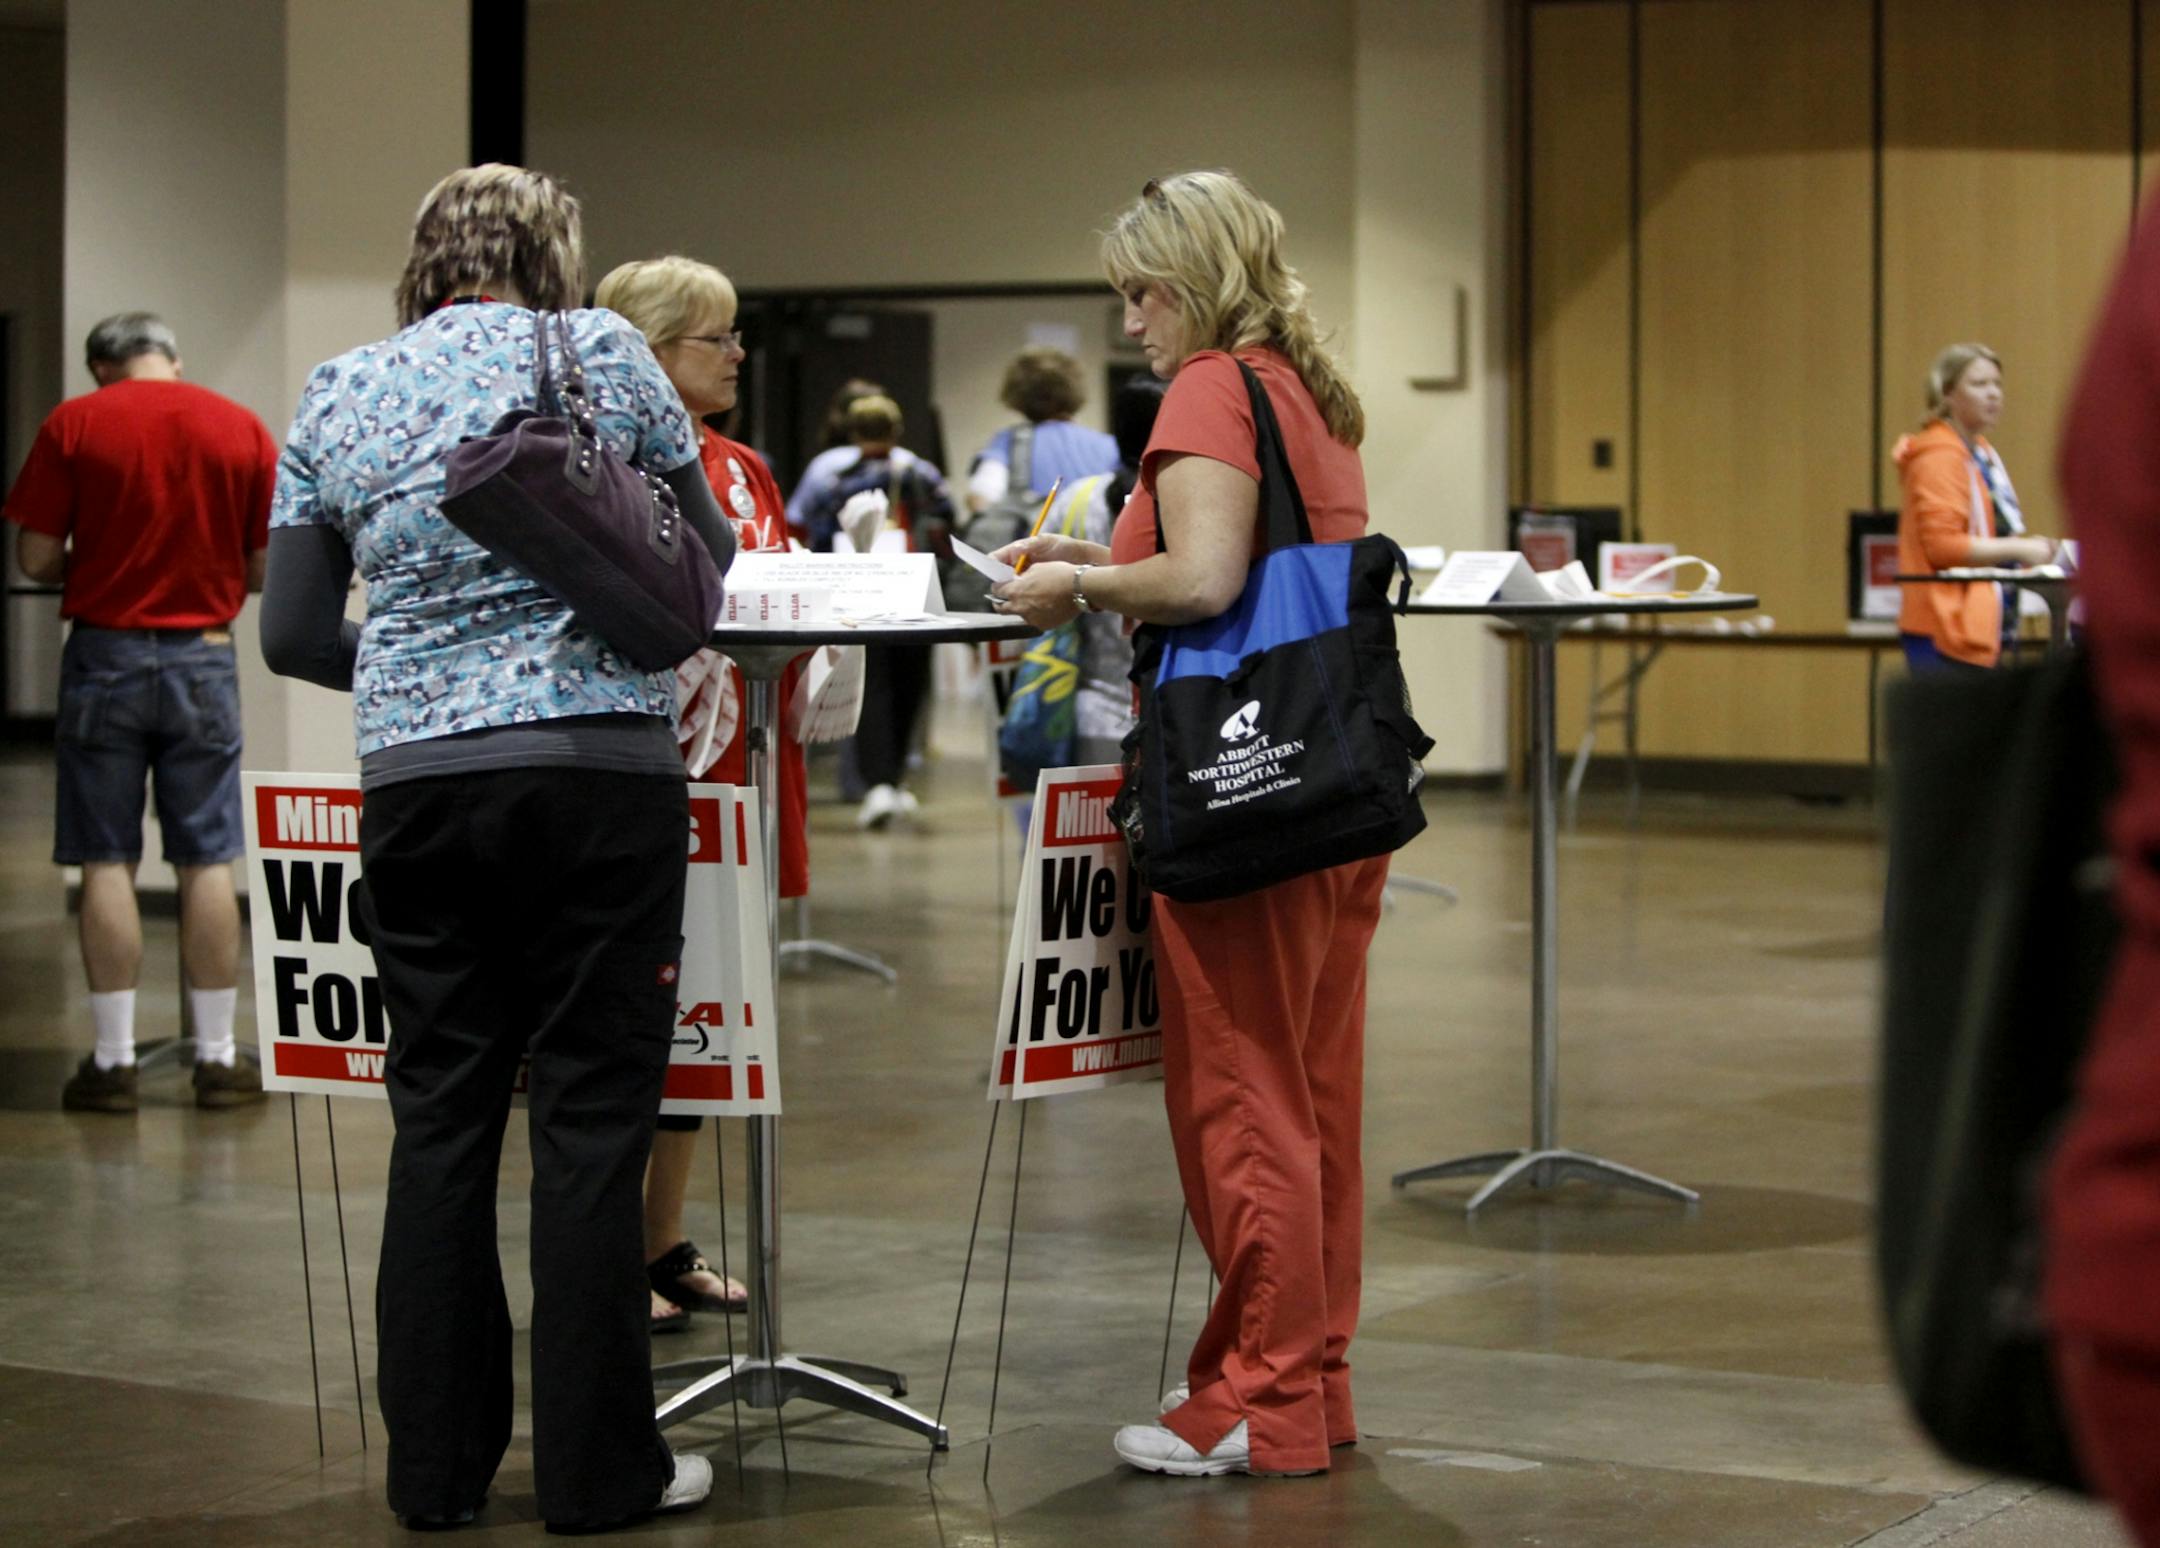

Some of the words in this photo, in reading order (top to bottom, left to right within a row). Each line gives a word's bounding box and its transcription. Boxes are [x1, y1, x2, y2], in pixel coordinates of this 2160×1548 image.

[1187, 739, 1306, 784] NORTHWESTERN
[1216, 734, 1271, 764] ABBOTT
[1214, 761, 1286, 793] HOSPITAL
[1041, 855, 1117, 942] We
[1029, 957, 1110, 1042] For
